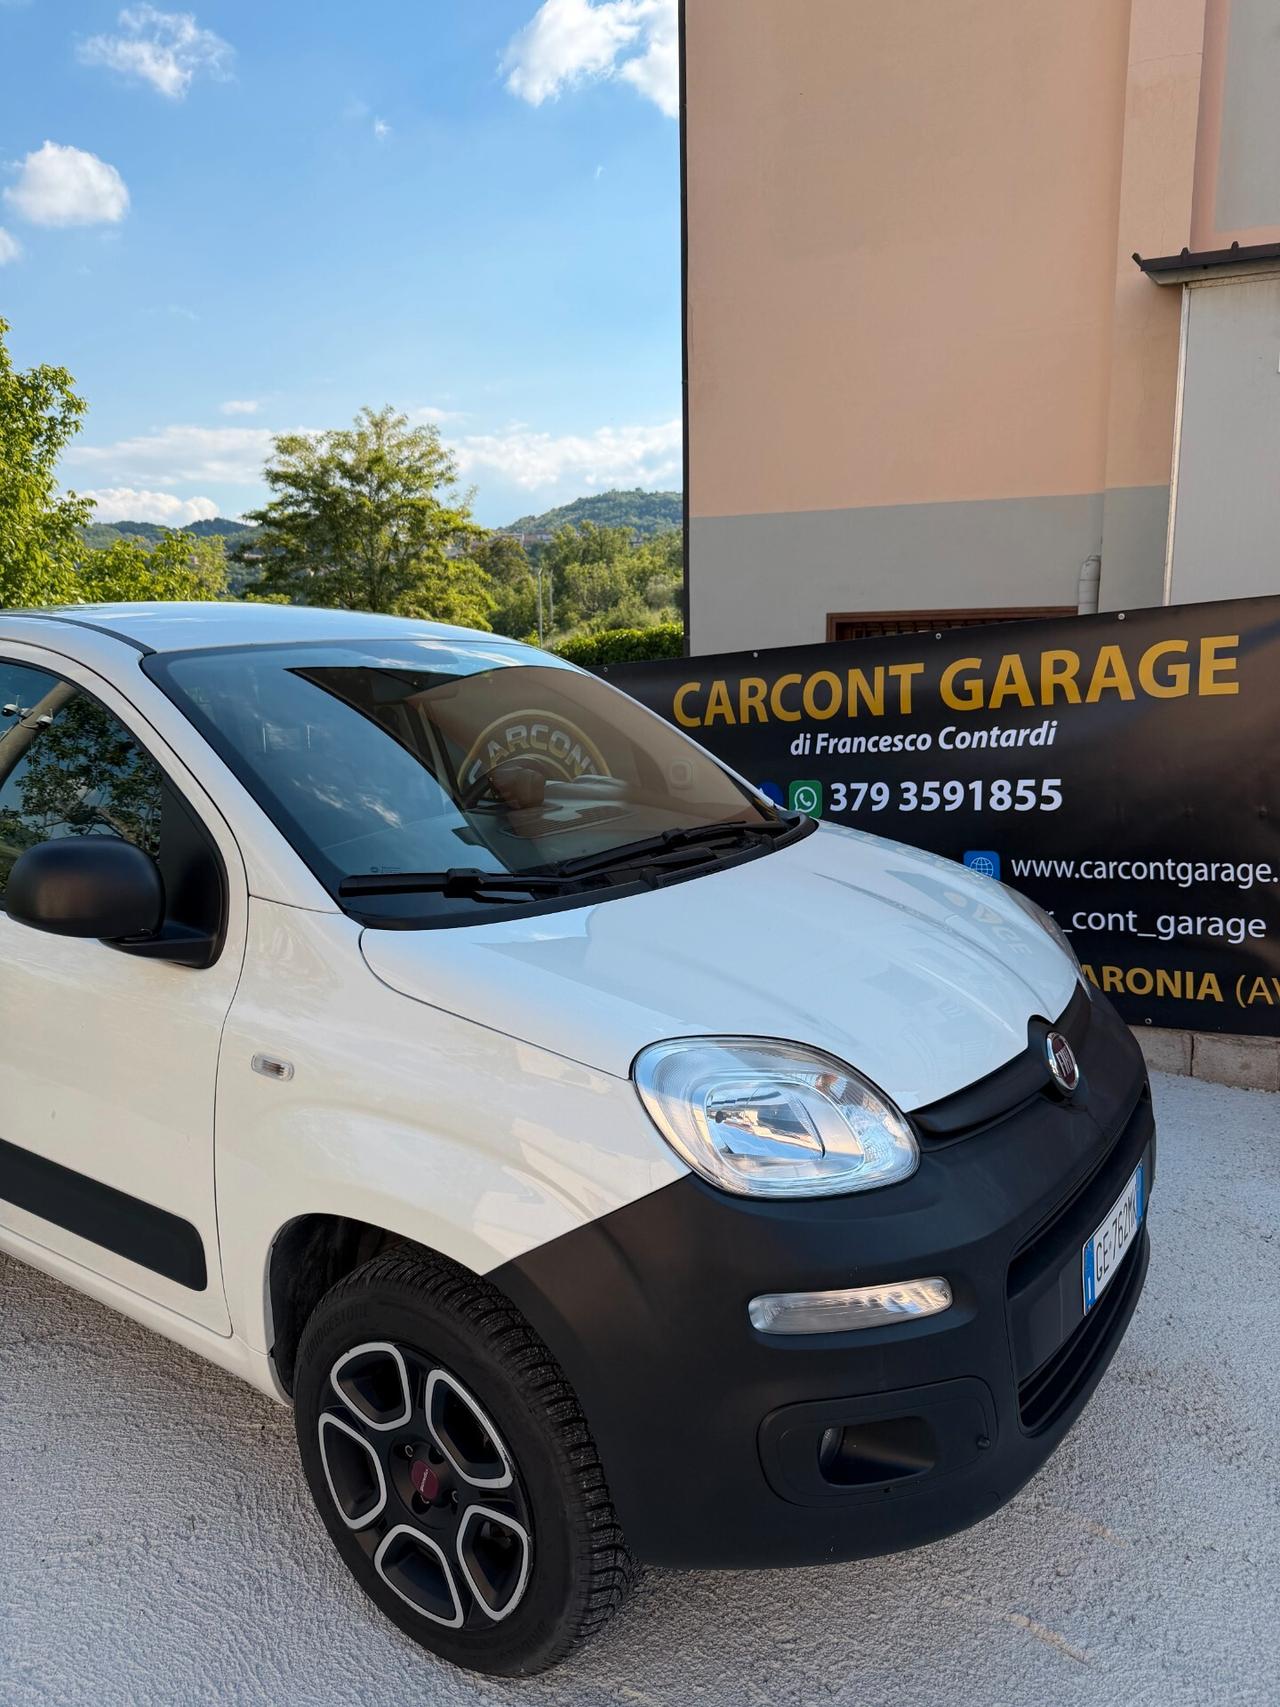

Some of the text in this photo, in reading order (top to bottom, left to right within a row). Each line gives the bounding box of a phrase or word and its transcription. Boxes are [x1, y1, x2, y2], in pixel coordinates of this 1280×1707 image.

[673, 635, 1240, 728] CARCONT GARAGE
[790, 720, 1058, 756] di Francesco Contardi
[829, 778, 1063, 812] 379 3591855
[1011, 858, 1279, 890] www.carcontgarage.
